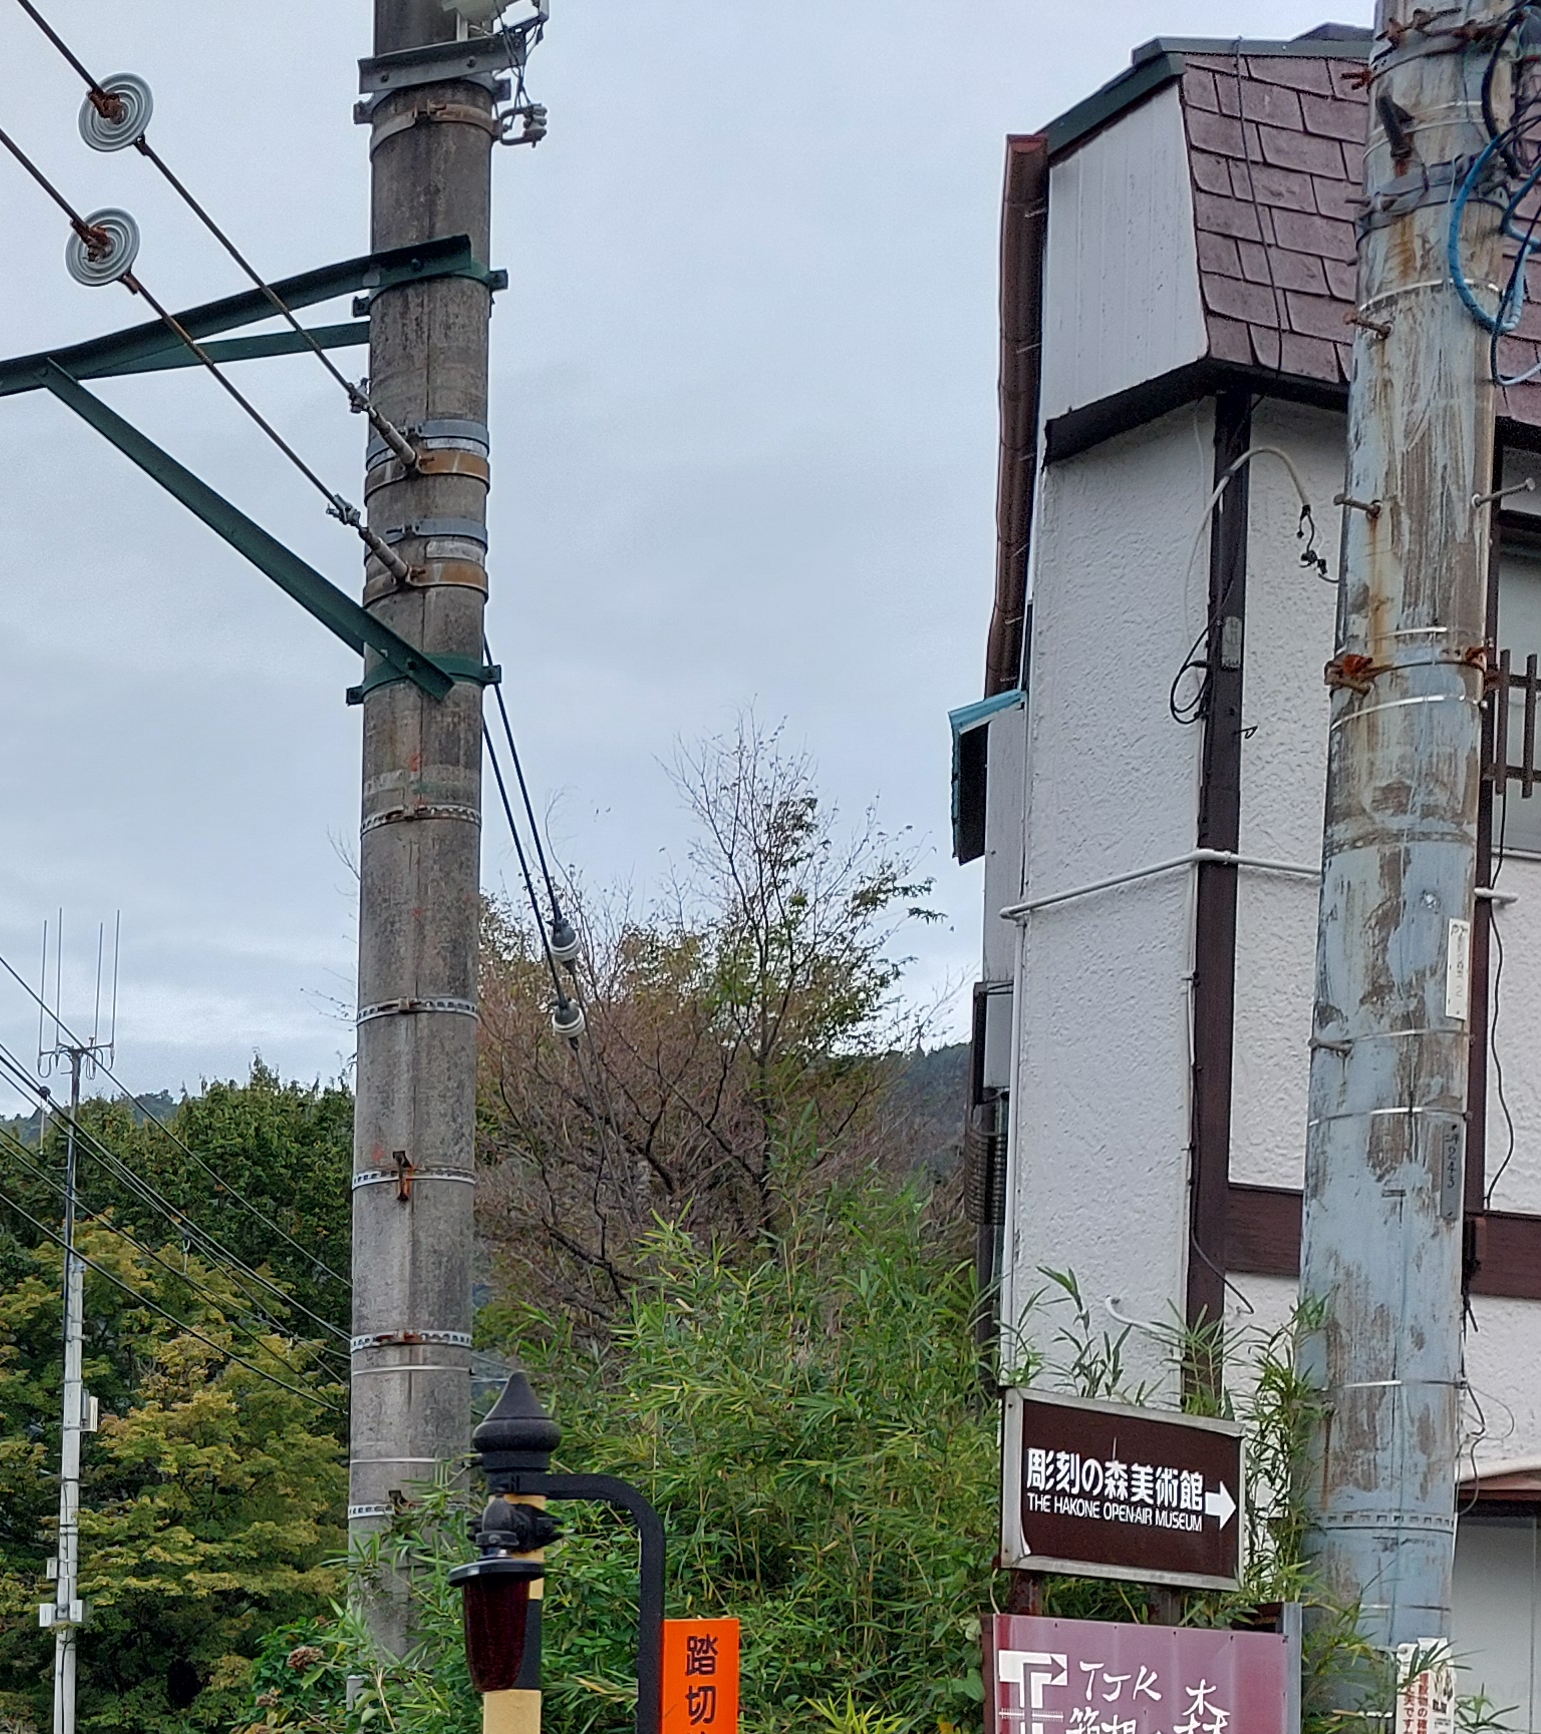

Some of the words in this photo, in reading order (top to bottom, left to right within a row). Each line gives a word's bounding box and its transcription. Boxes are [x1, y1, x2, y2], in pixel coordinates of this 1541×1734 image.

[1027, 1448, 1203, 1511] 彫刻の森美術館
[1027, 1492, 1050, 1513] THE
[1054, 1496, 1101, 1519] HAKONE
[1103, 1502, 1153, 1526] OPEN-AIR
[1155, 1508, 1203, 1532] MUSEUM
[1079, 1660, 1162, 1703] TJK
